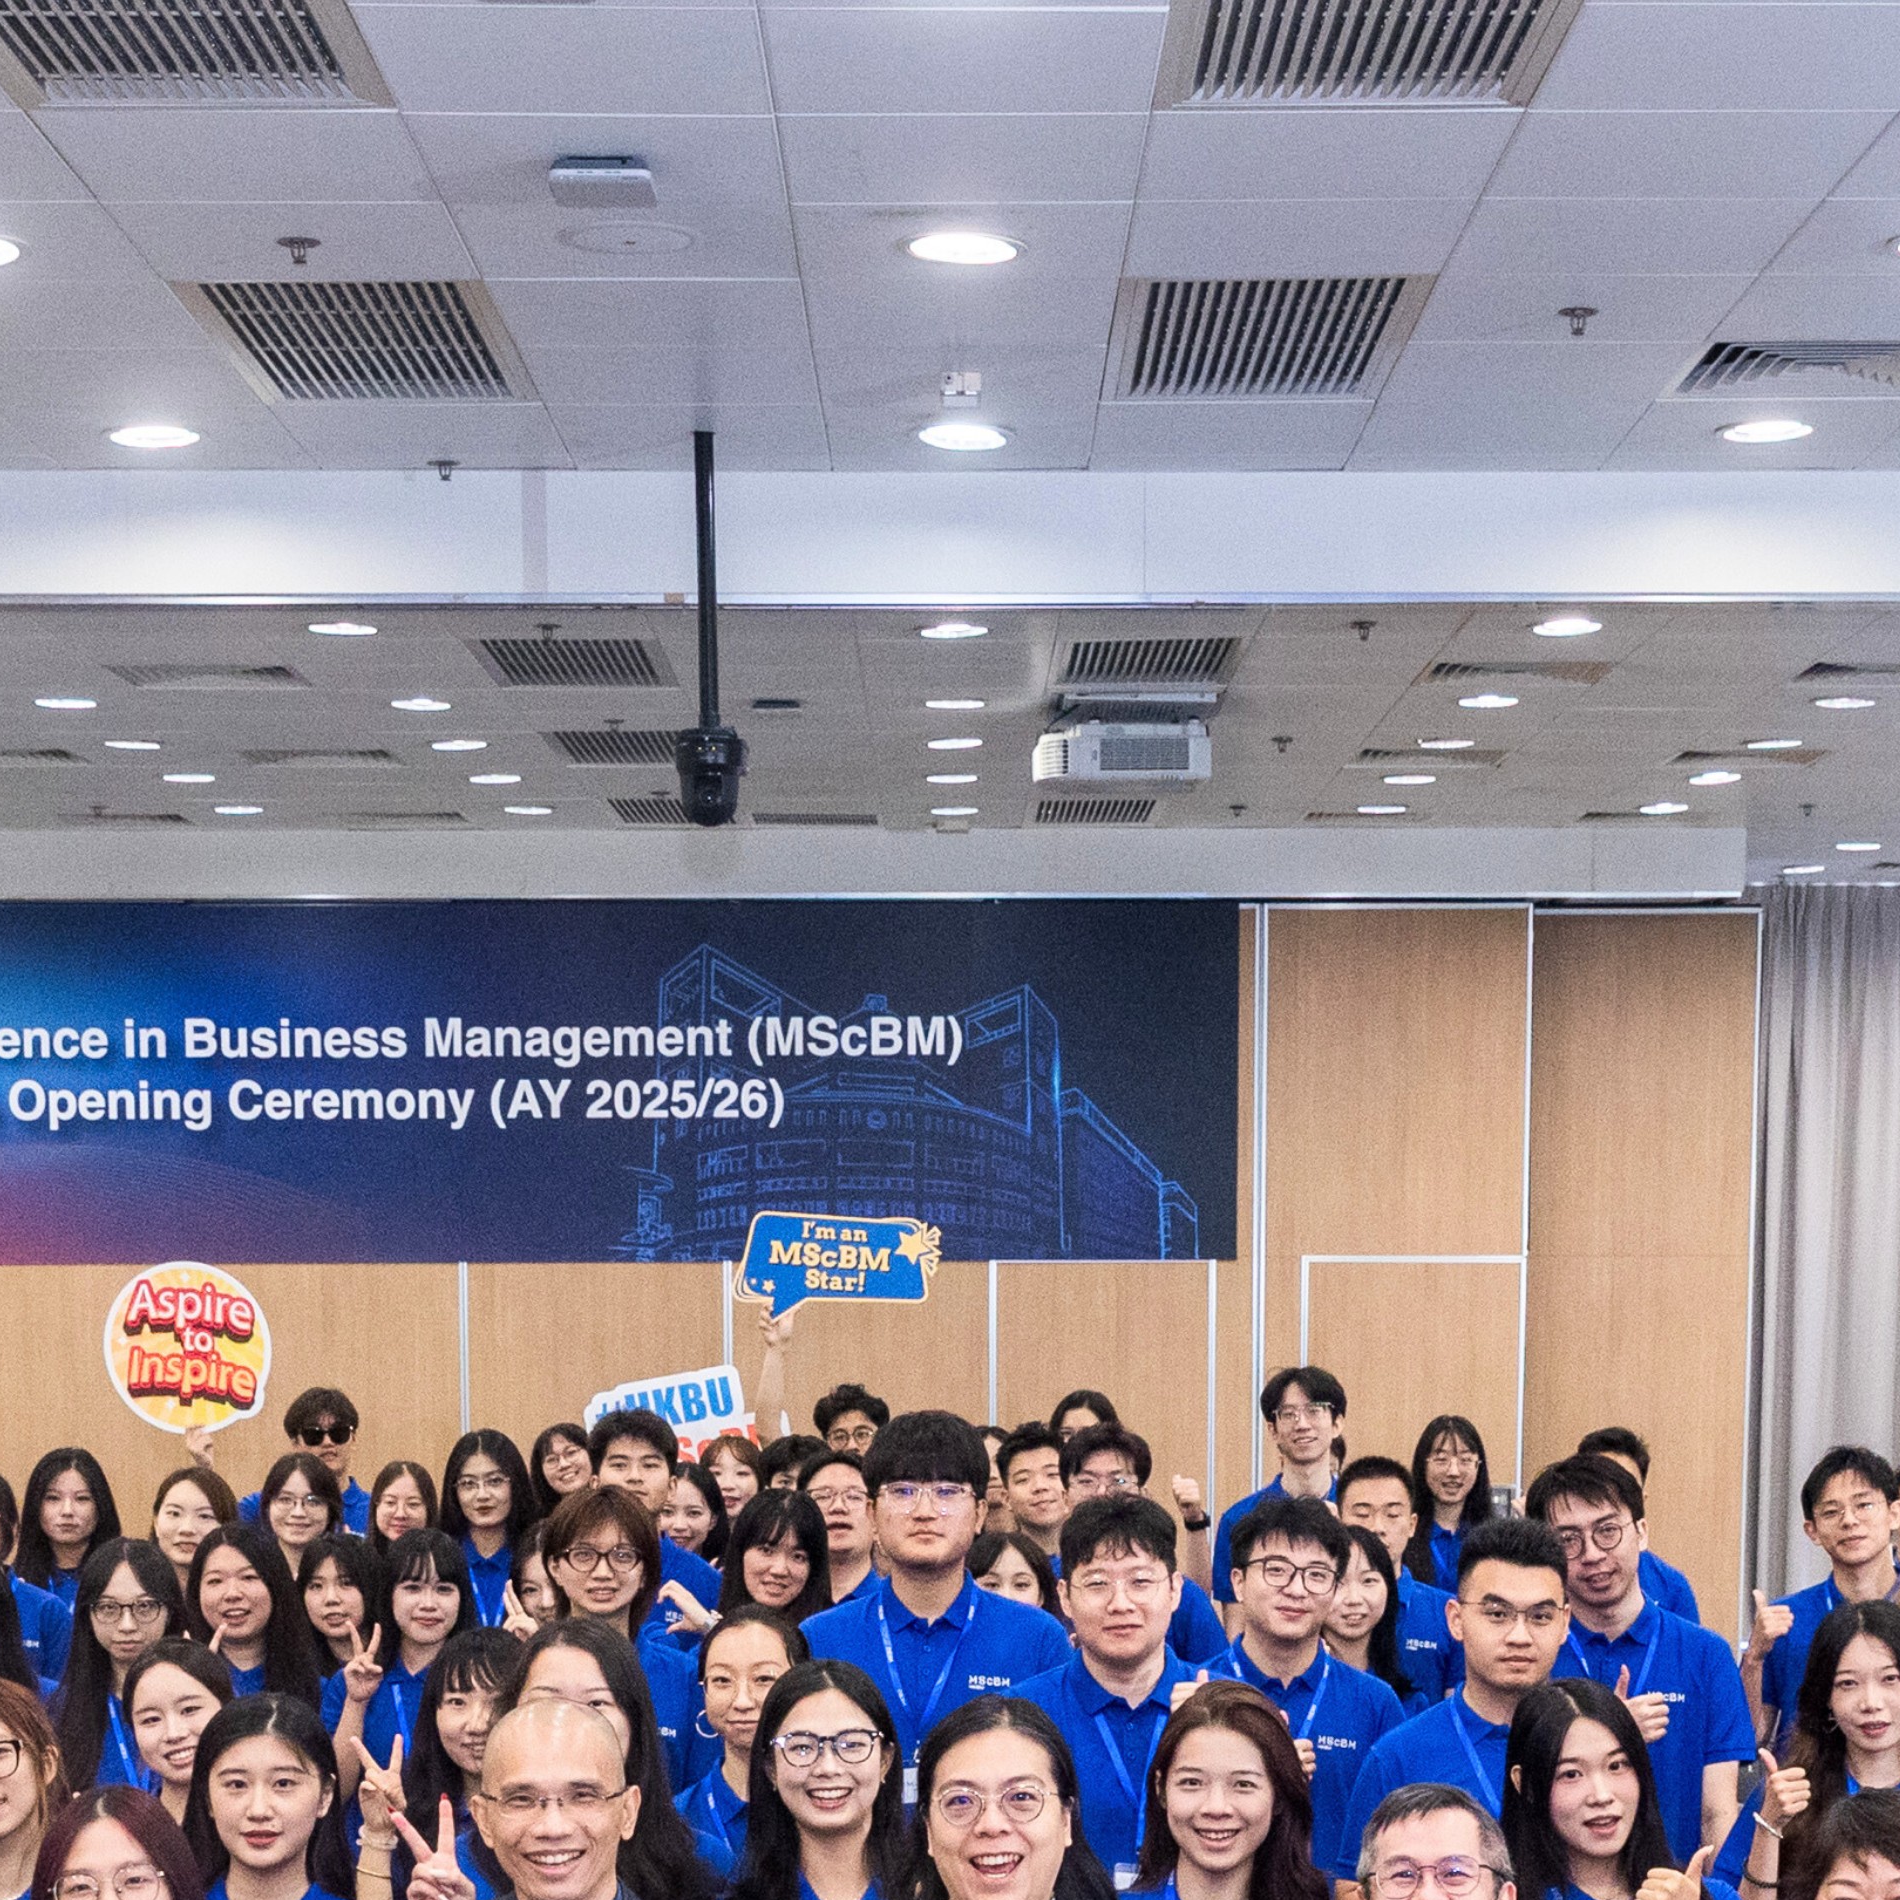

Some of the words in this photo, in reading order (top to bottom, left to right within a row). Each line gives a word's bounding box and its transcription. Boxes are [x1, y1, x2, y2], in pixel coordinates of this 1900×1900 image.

[124, 1017, 167, 1058] in
[183, 1018, 408, 1059] Business
[424, 1016, 733, 1068] Management
[747, 1015, 964, 1066] (MScBM)
[8, 1079, 212, 1131] Opening
[228, 1078, 475, 1130] Ceremony
[490, 1077, 571, 1129] (AY
[586, 1076, 784, 1129] 2025/26)
[801, 1221, 837, 1241] I'm
[839, 1227, 869, 1243] an
[768, 1240, 892, 1273] MScBM
[804, 1268, 867, 1294] Star!
[125, 1280, 255, 1338] Aspire
[182, 1326, 214, 1354] to
[128, 1347, 257, 1403] Inspire
[968, 1674, 1011, 1688] MScBM
[1317, 1734, 1358, 1750] MScBM
